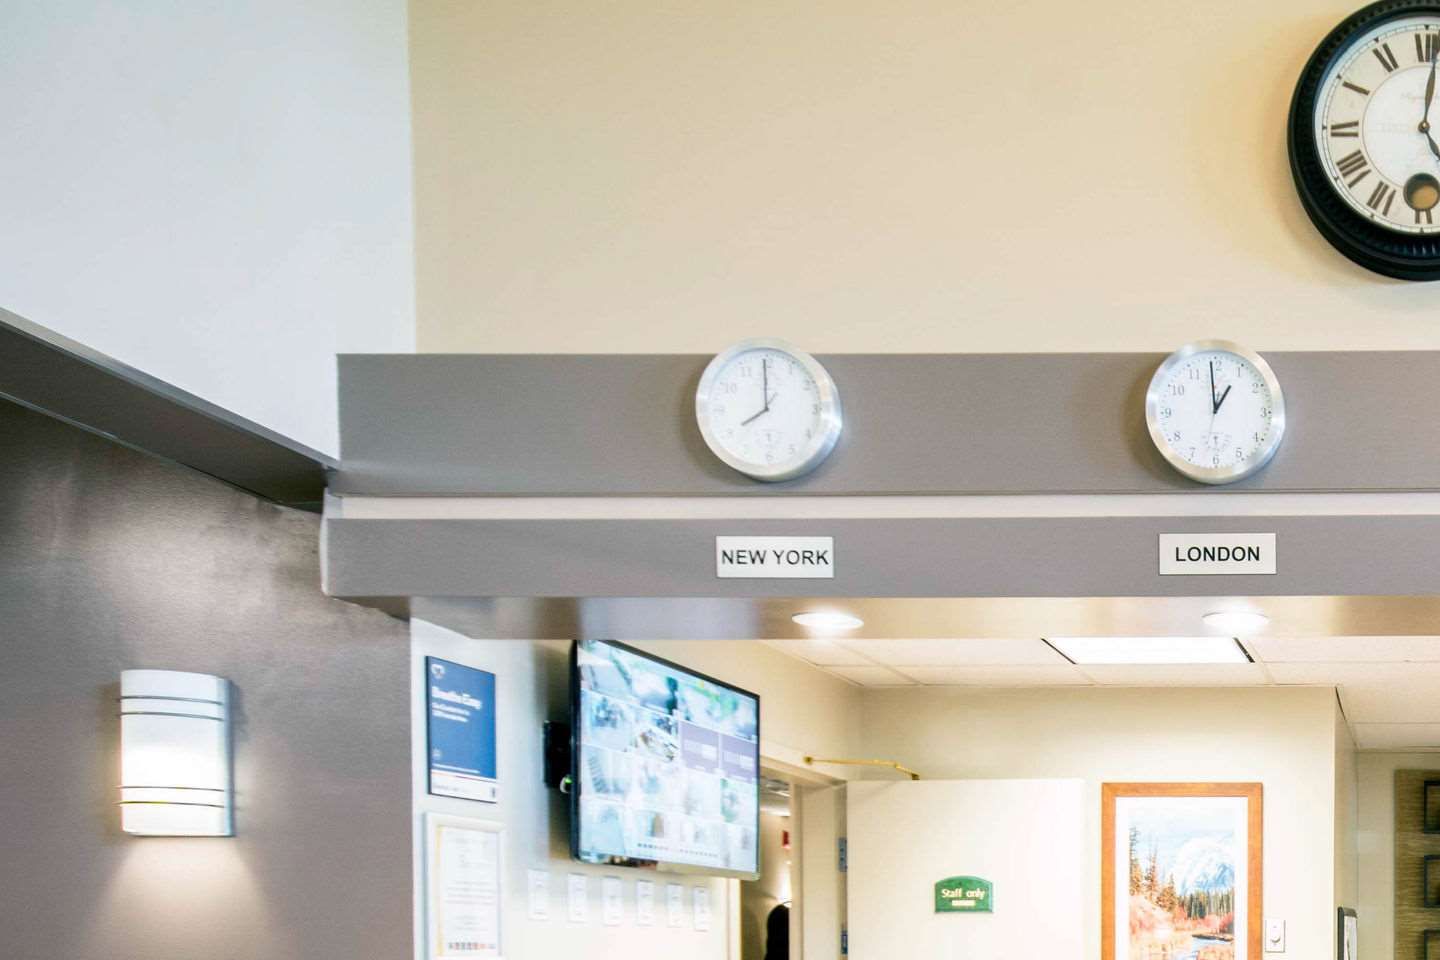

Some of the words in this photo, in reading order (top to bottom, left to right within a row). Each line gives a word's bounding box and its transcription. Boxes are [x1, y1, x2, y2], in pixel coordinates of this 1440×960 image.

[1187, 369, 1201, 380] 11
[1171, 385, 1185, 396] 10
[1164, 408, 1172, 418] 9
[1260, 408, 1268, 418] 3
[1174, 432, 1181, 442] 8
[1235, 448, 1243, 458] 5
[1212, 455, 1220, 465] 6
[721, 550, 767, 565] NEW
[773, 550, 830, 566] YORK
[1175, 546, 1260, 562] LONDON
[941, 888, 962, 898] Staff
[966, 888, 985, 900] only
